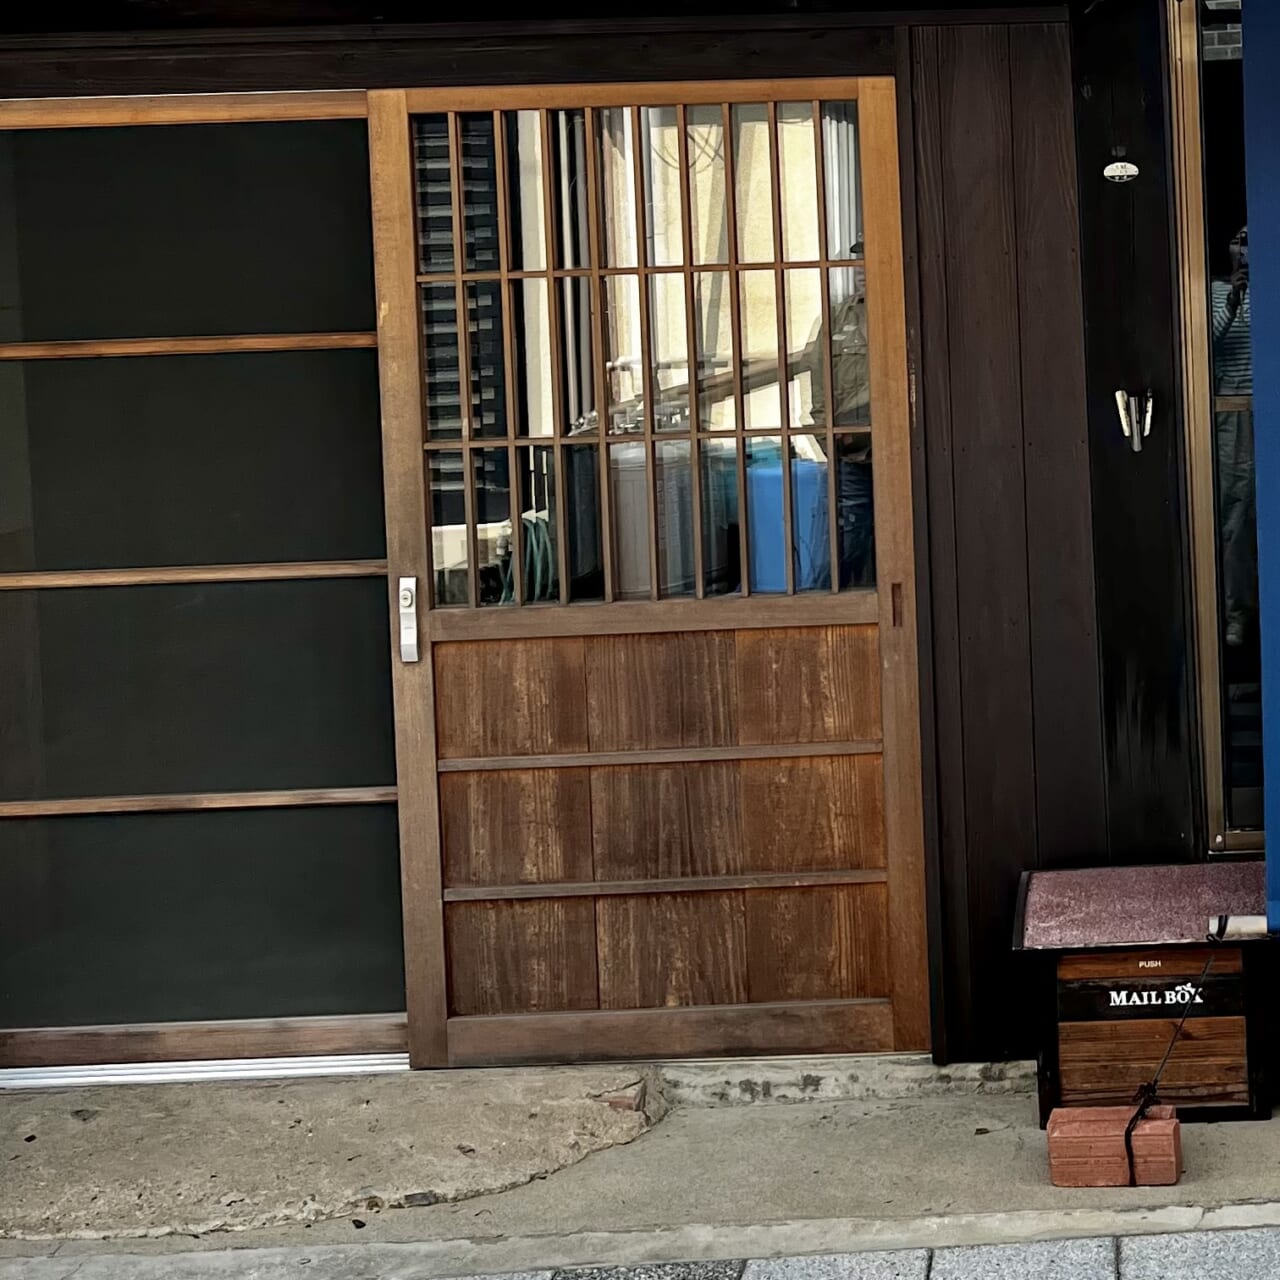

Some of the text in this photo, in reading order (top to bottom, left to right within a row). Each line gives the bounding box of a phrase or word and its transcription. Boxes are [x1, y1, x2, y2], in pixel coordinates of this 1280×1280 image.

[1139, 960, 1162, 968] PUSH
[1108, 986, 1204, 1007] MAIL BOX
